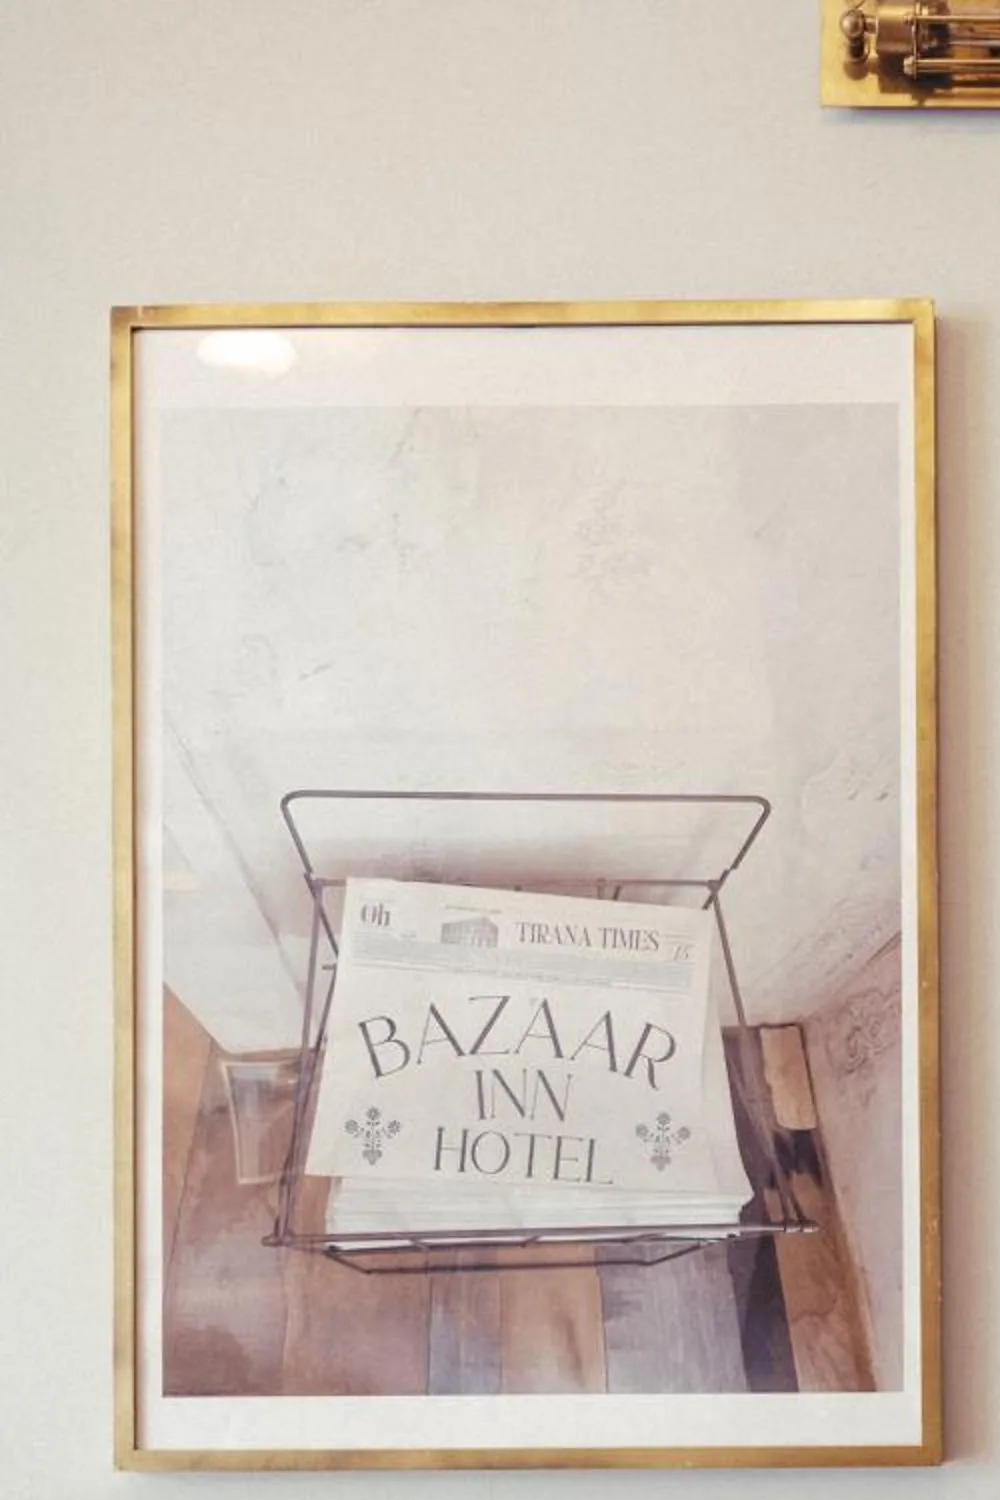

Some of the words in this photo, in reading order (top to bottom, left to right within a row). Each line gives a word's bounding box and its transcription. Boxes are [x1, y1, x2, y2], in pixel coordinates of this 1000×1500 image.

[515, 921, 590, 949] TIRANA
[597, 926, 661, 953] TIMES
[358, 994, 676, 1090] BAZAAR
[474, 1068, 573, 1122] INN
[434, 1126, 613, 1185] HOTEL
